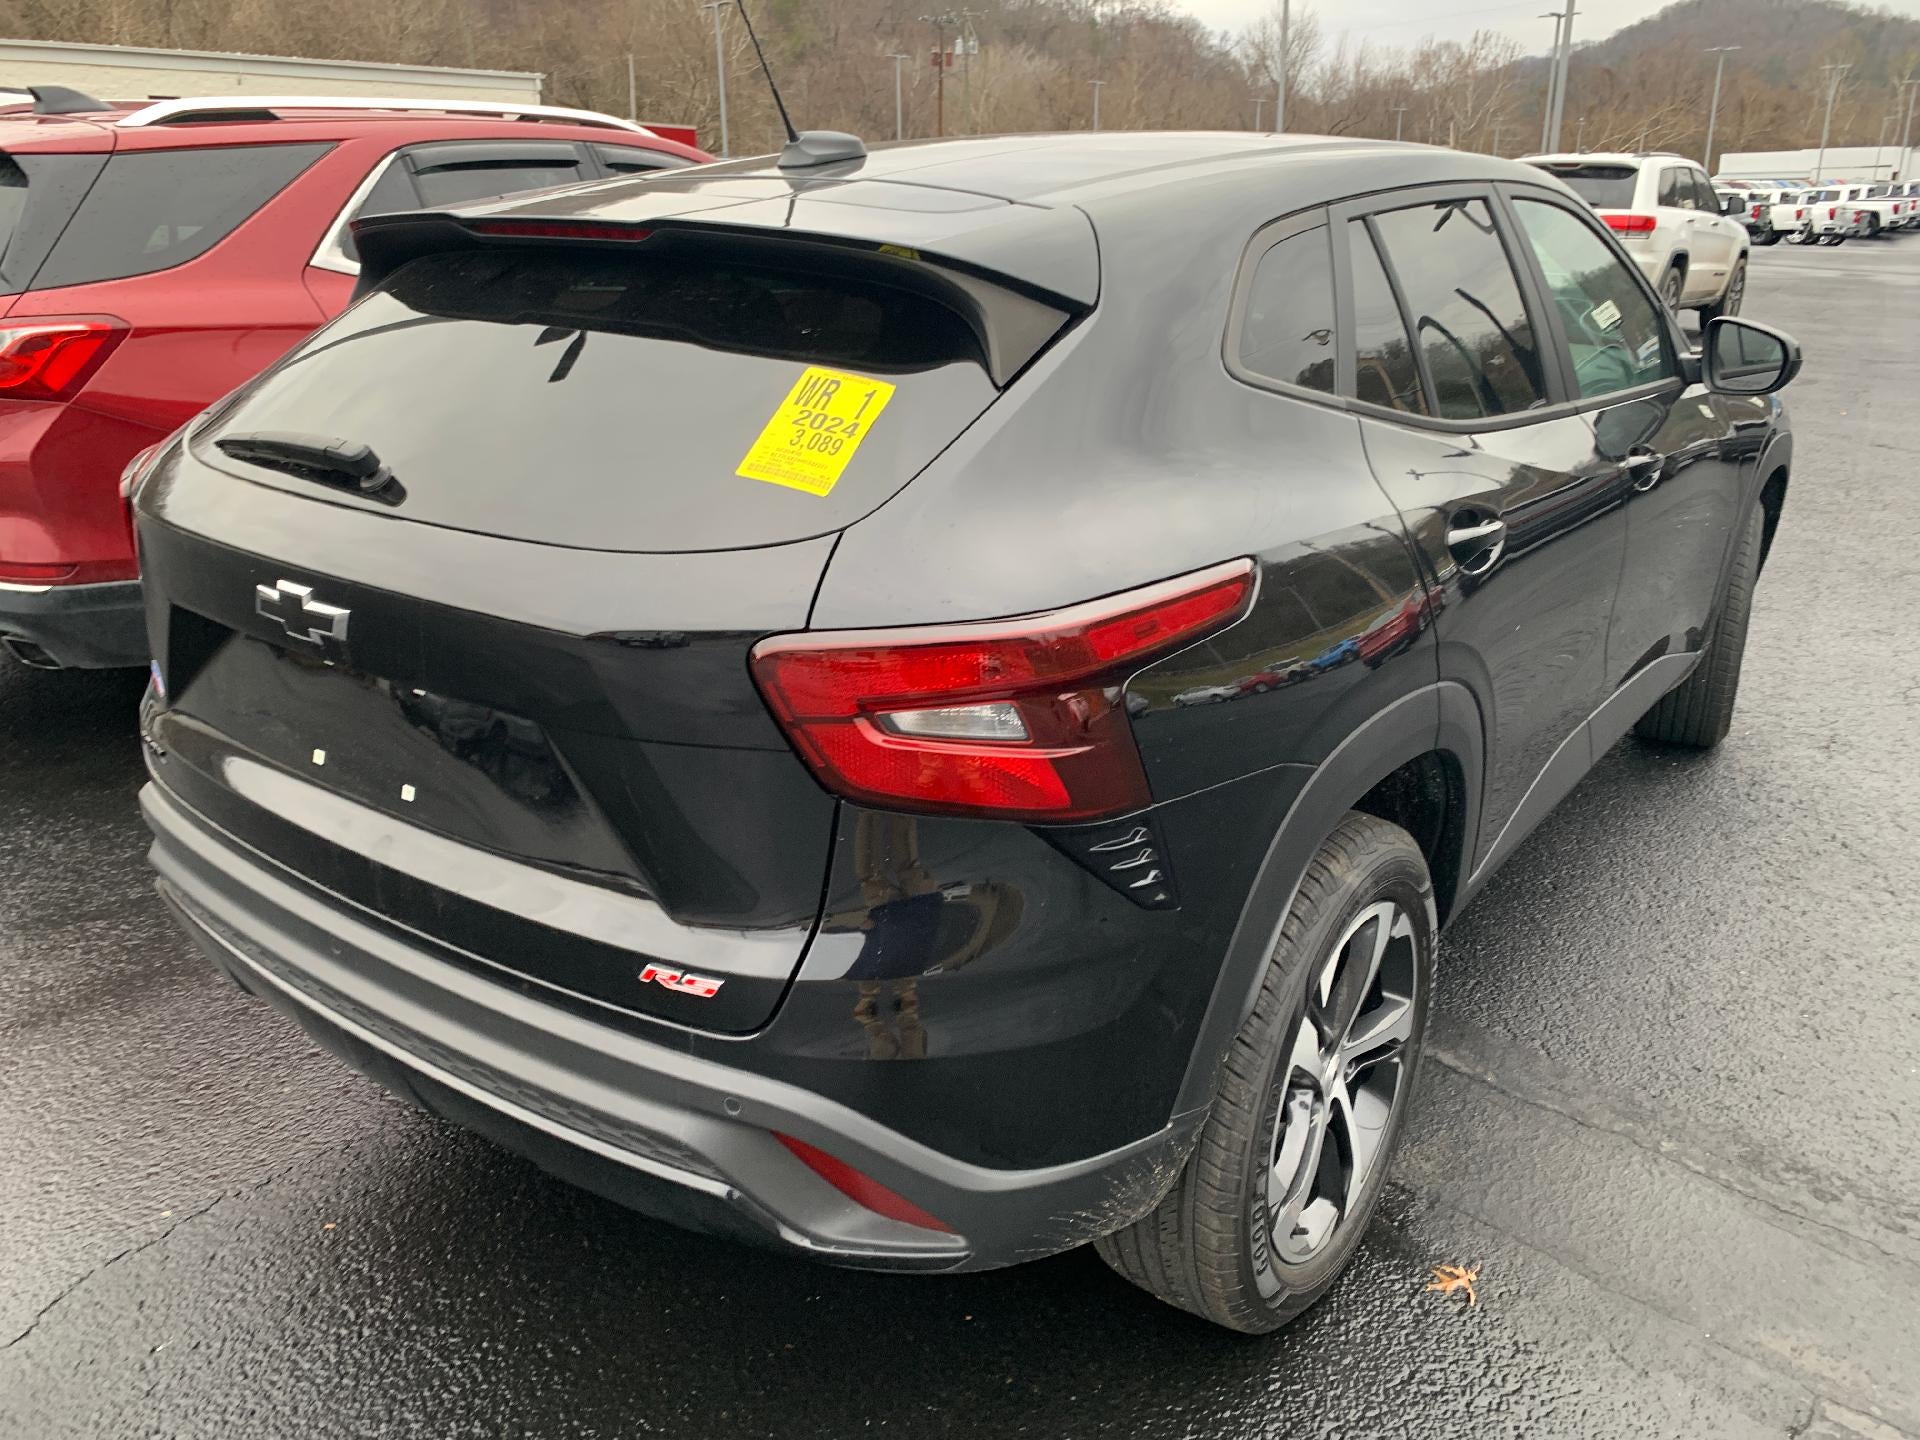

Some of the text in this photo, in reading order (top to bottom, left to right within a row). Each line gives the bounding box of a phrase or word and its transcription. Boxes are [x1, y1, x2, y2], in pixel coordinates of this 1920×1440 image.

[794, 375, 877, 420] WR 1
[792, 409, 860, 439] 2024
[790, 429, 844, 456] 3,089
[639, 963, 725, 998] RS
